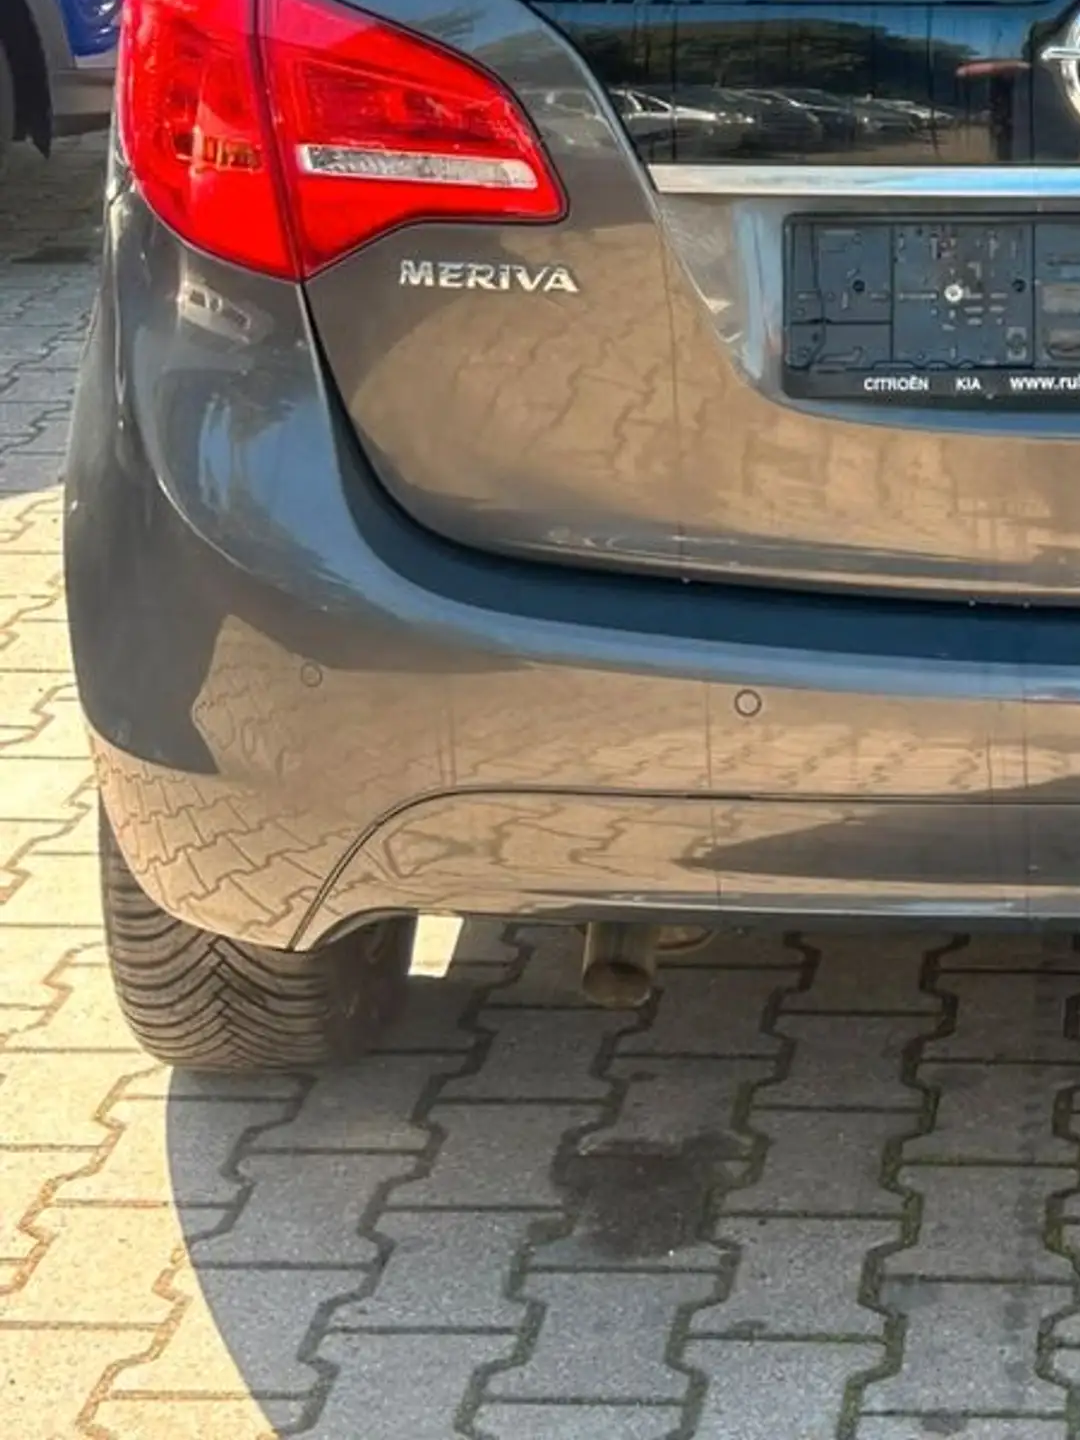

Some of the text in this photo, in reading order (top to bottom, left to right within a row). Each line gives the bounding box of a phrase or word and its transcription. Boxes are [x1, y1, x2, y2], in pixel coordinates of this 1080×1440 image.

[399, 260, 580, 292] MERIVA
[863, 375, 929, 391] CITROËN
[955, 376, 981, 391] KIA
